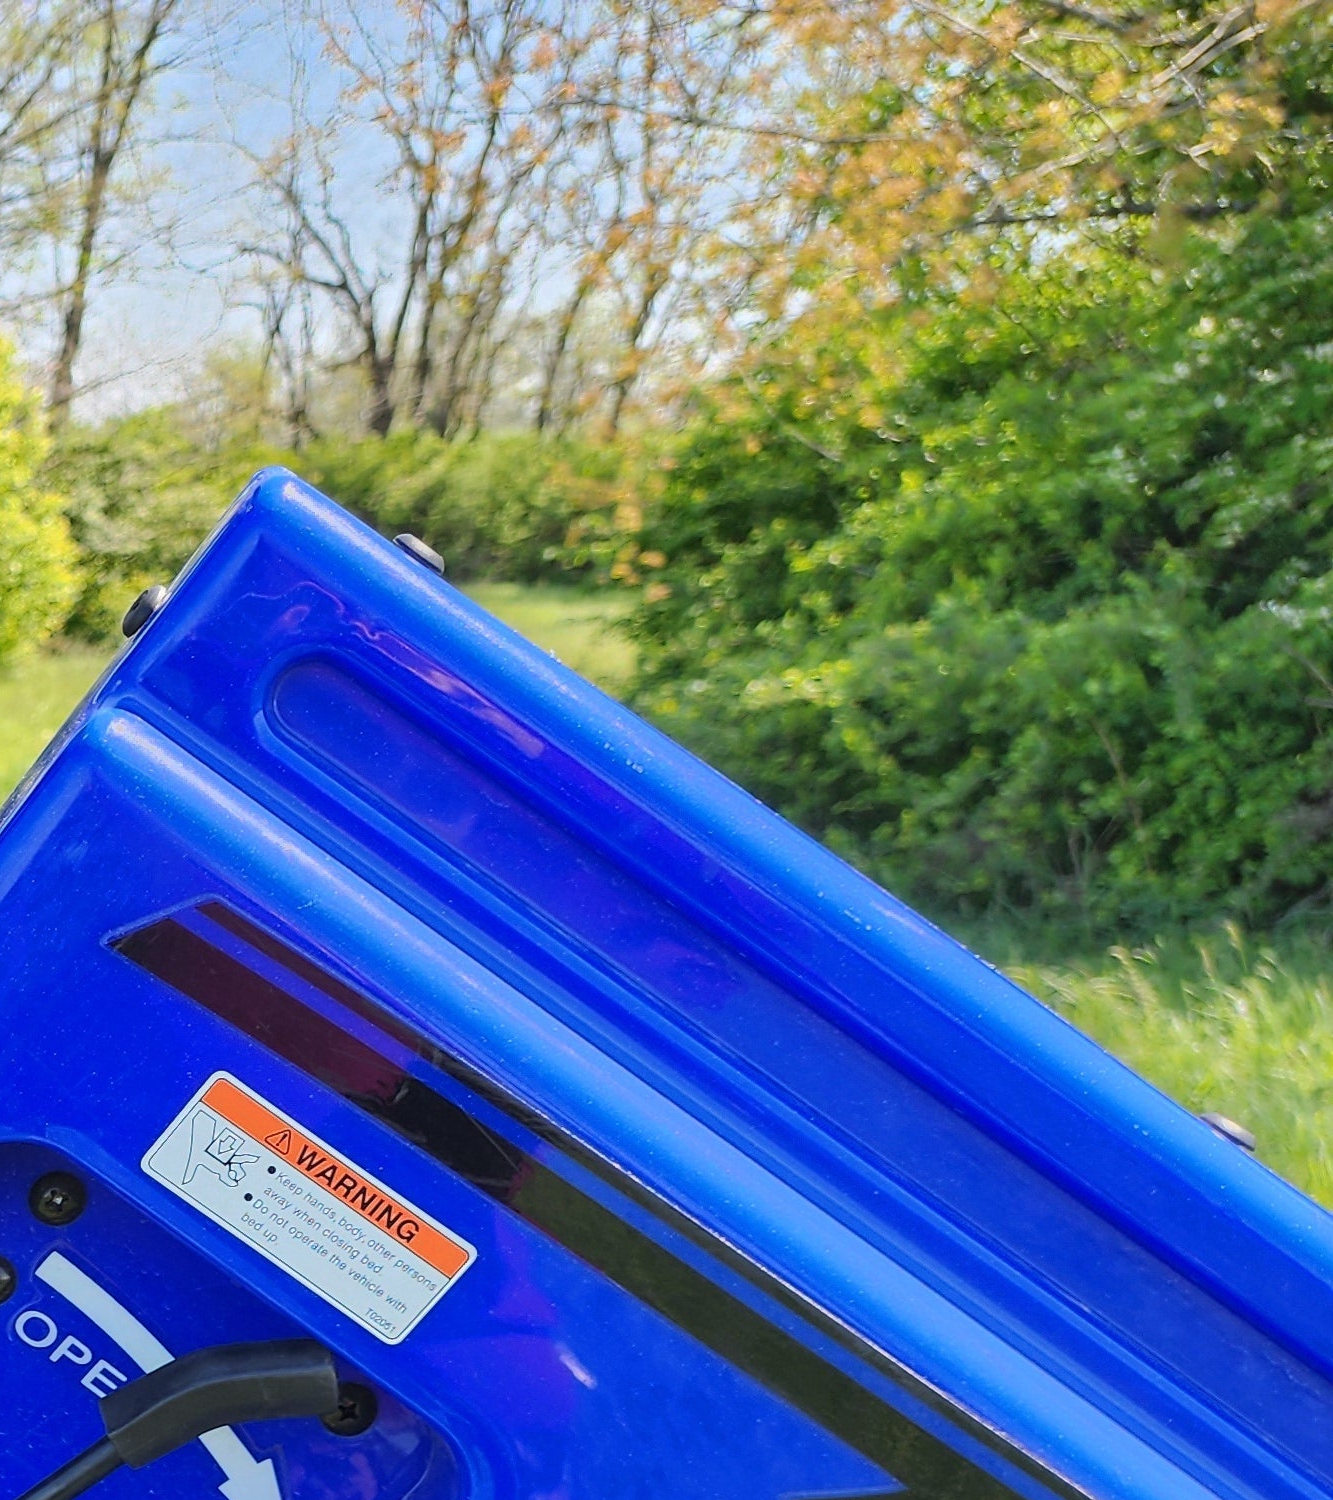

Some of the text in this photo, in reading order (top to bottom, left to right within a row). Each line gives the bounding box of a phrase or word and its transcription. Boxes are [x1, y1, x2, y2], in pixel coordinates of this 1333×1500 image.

[239, 1211, 264, 1232] bed
[260, 1185, 293, 1212] away
[291, 1205, 323, 1231] when
[318, 1226, 362, 1260] closing
[273, 1171, 438, 1293] Keep hands, body, other persons
[291, 1144, 424, 1244] WARNING
[251, 1197, 409, 1314] Do not operate the vehicle with
[15, 1310, 128, 1399] OPE
